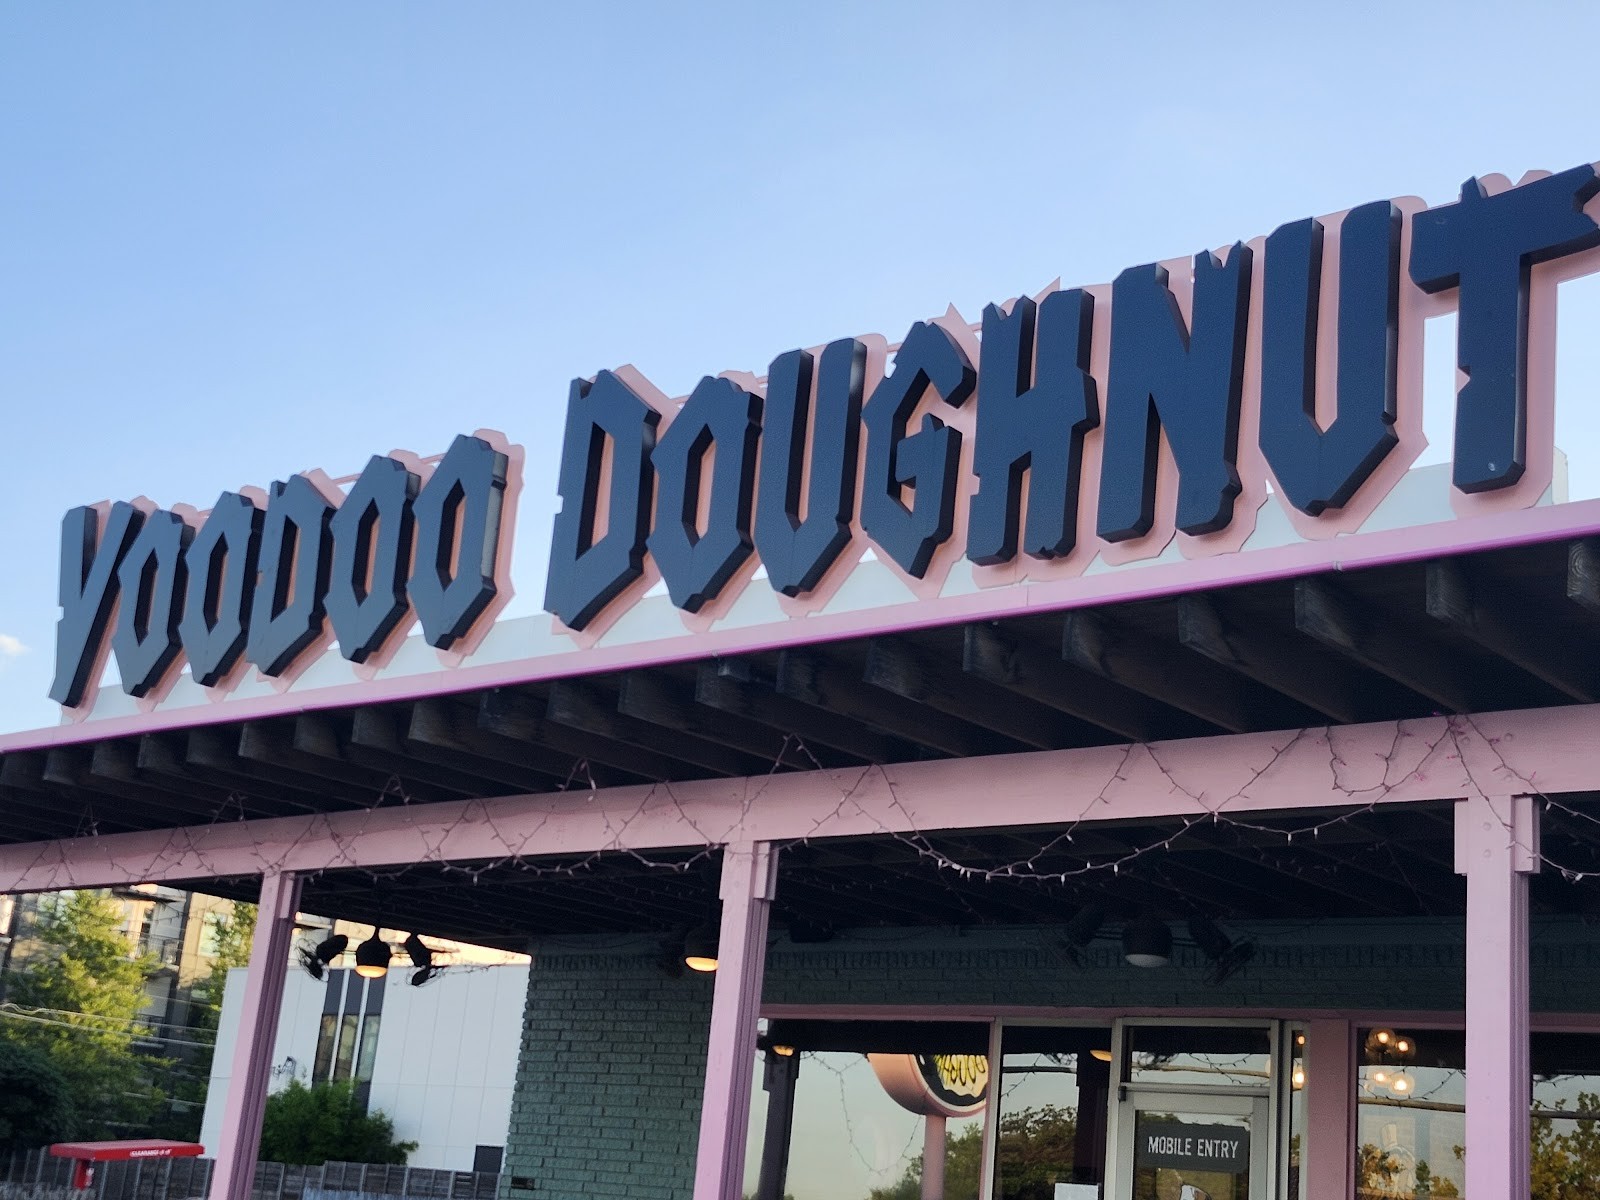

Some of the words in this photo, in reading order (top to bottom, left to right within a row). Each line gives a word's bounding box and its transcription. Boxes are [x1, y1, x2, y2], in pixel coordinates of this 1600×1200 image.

[48, 434, 509, 708] VOODOO
[545, 162, 1600, 631] DOUGHNUT
[1148, 1136, 1192, 1156] MOBILE
[1197, 1138, 1239, 1159] ENTRY
